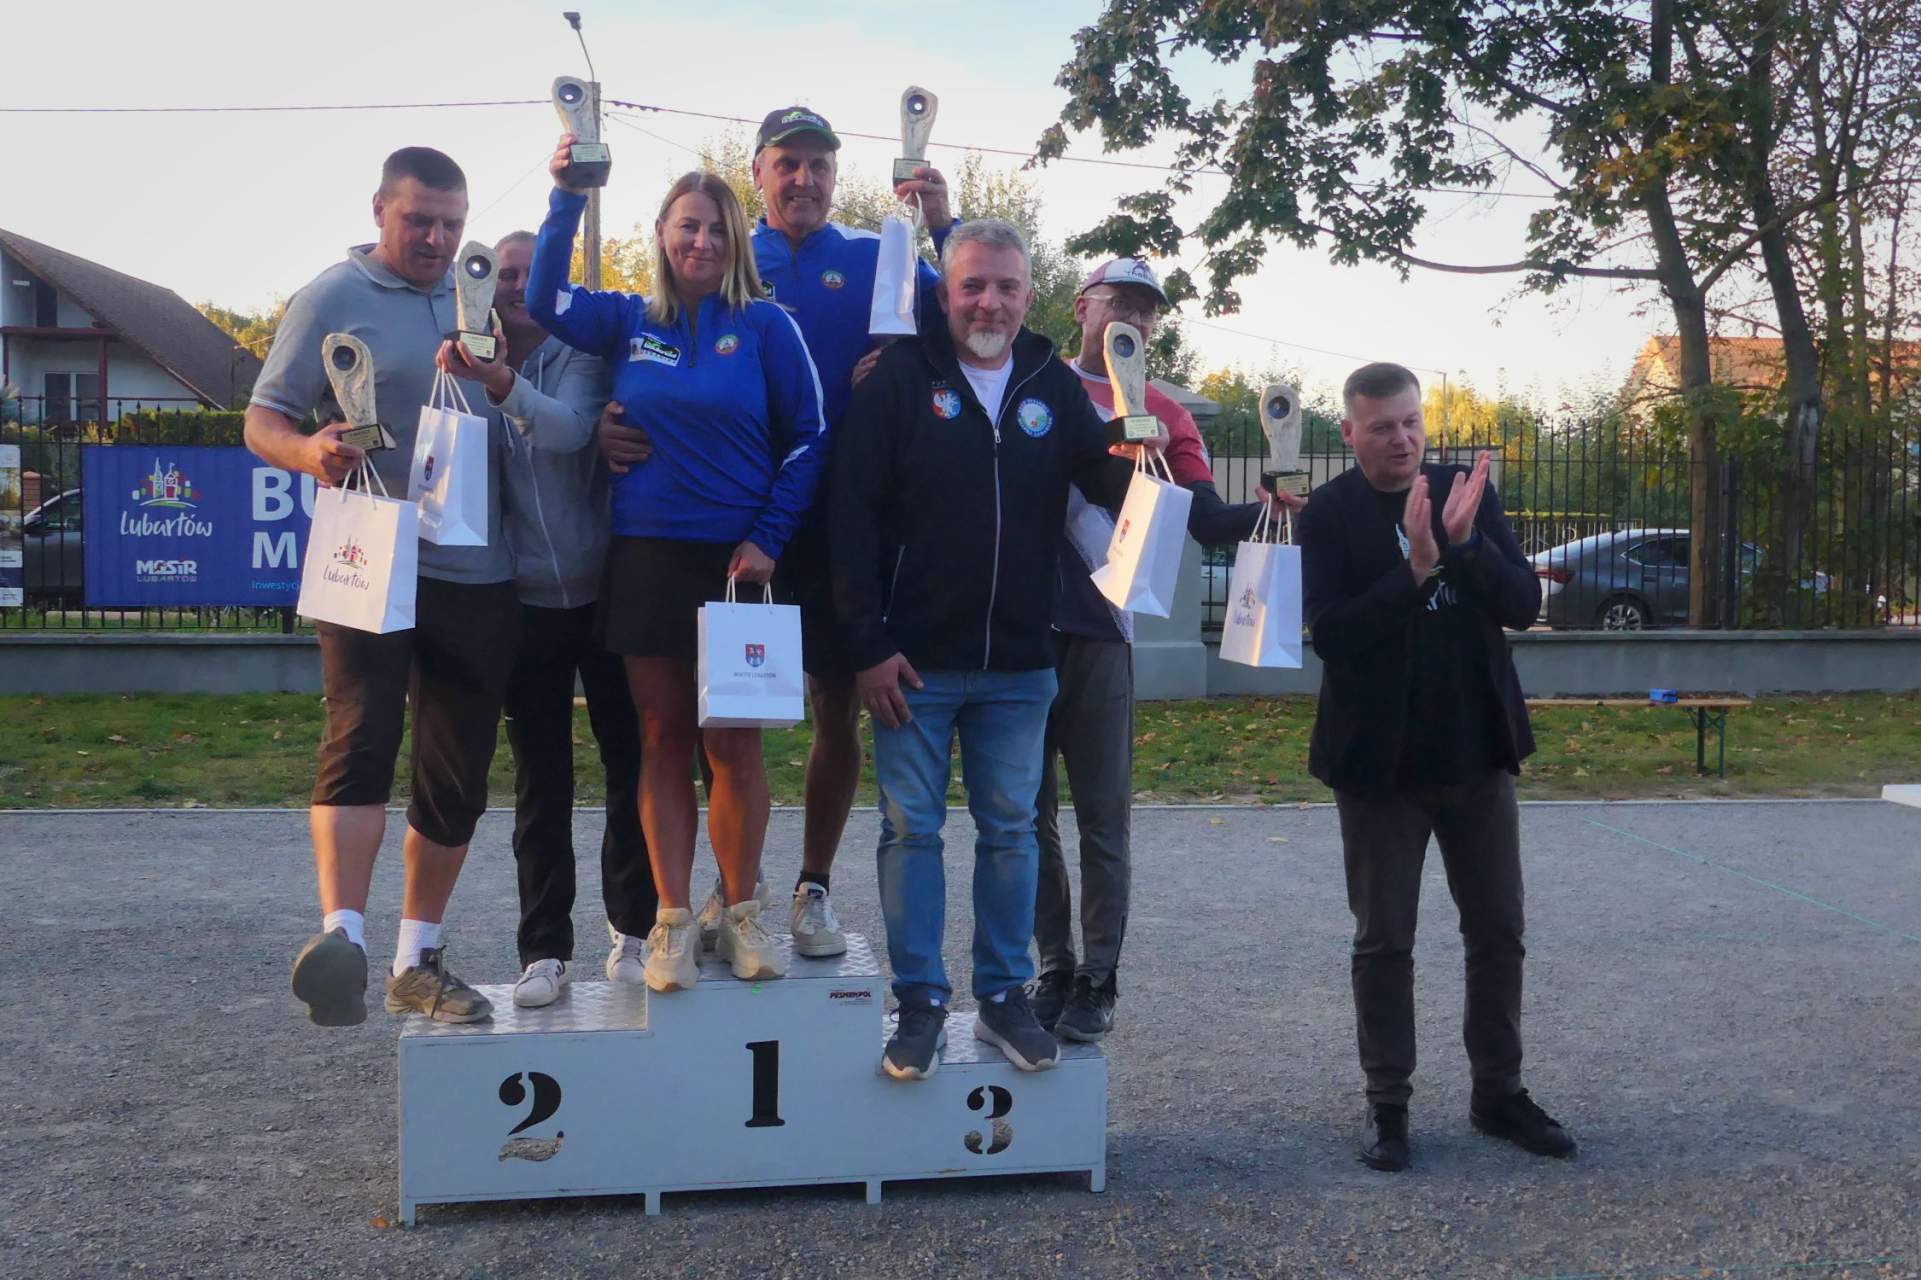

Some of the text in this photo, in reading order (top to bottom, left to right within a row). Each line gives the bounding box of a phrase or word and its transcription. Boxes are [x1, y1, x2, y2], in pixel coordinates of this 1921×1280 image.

[120, 510, 213, 537] Lubartów
[498, 1071, 563, 1162] 2
[744, 1039, 786, 1128] 1
[963, 1085, 1013, 1155] 3
